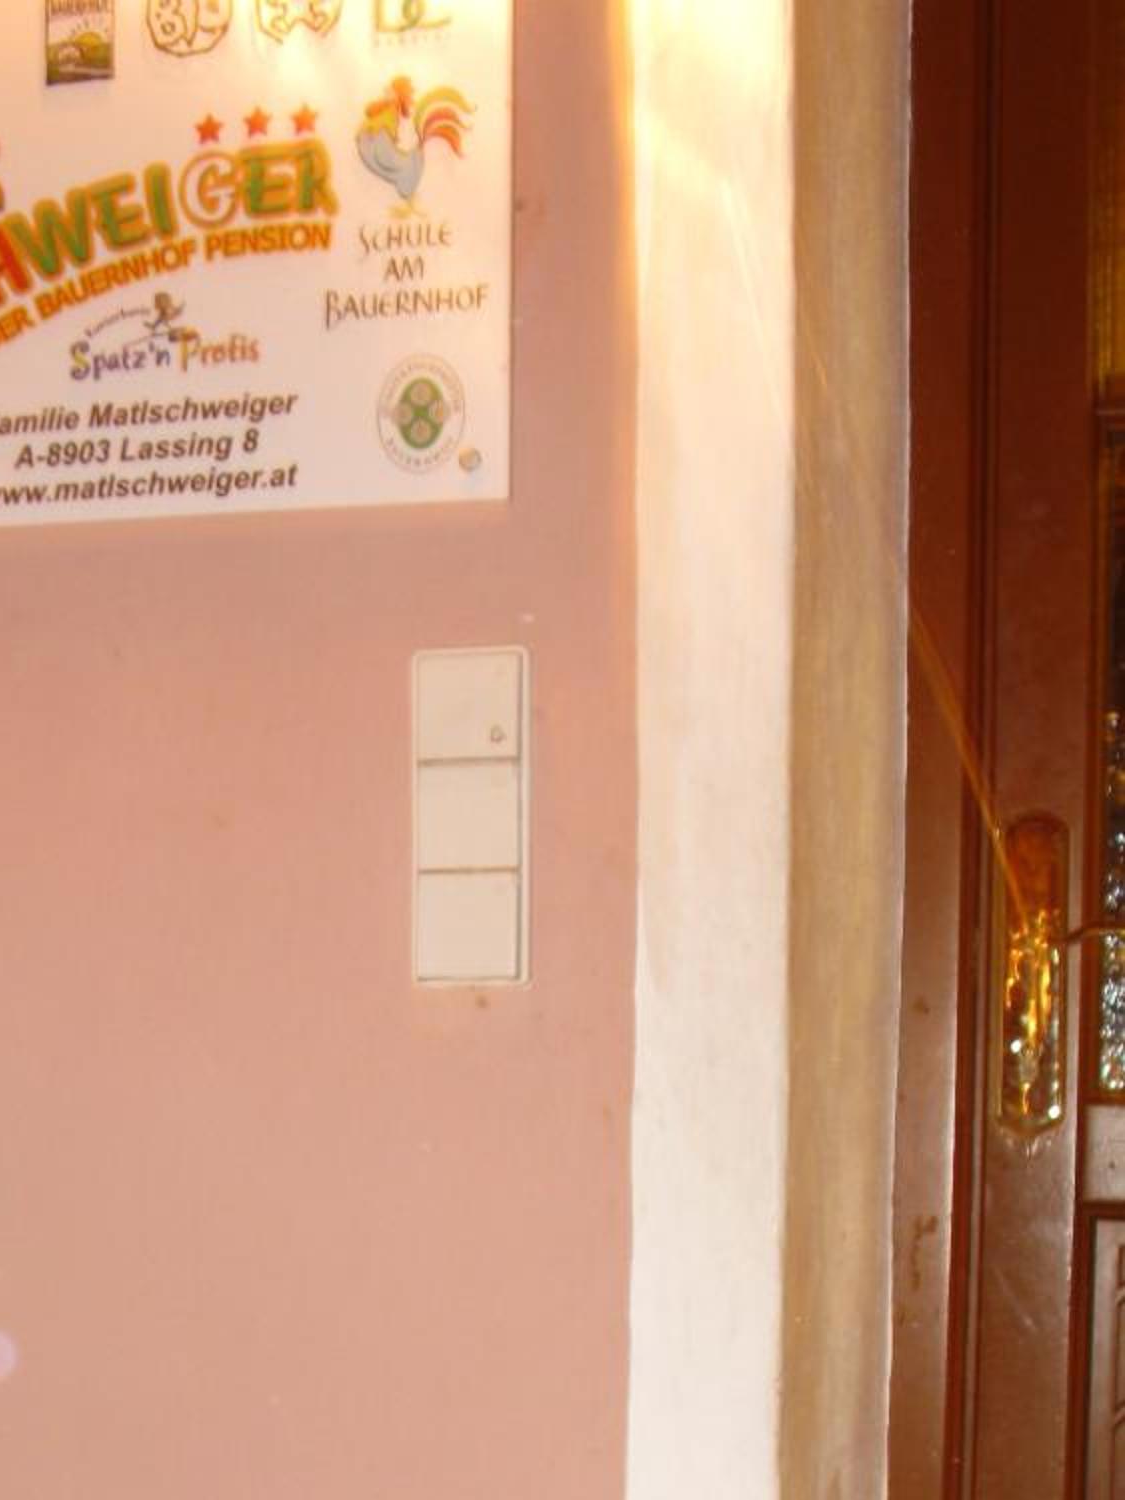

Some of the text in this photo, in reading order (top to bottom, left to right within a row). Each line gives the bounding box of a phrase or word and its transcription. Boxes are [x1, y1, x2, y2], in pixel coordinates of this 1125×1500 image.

[358, 222, 453, 257] SCHULE
[33, 238, 197, 321] BAUERNHOF
[204, 221, 332, 261] PENSION
[383, 255, 426, 283] AM
[324, 283, 490, 331] BAUERNHOF
[88, 393, 298, 429] Matlschweiger
[14, 427, 260, 470] A-8903 Lassing 8
